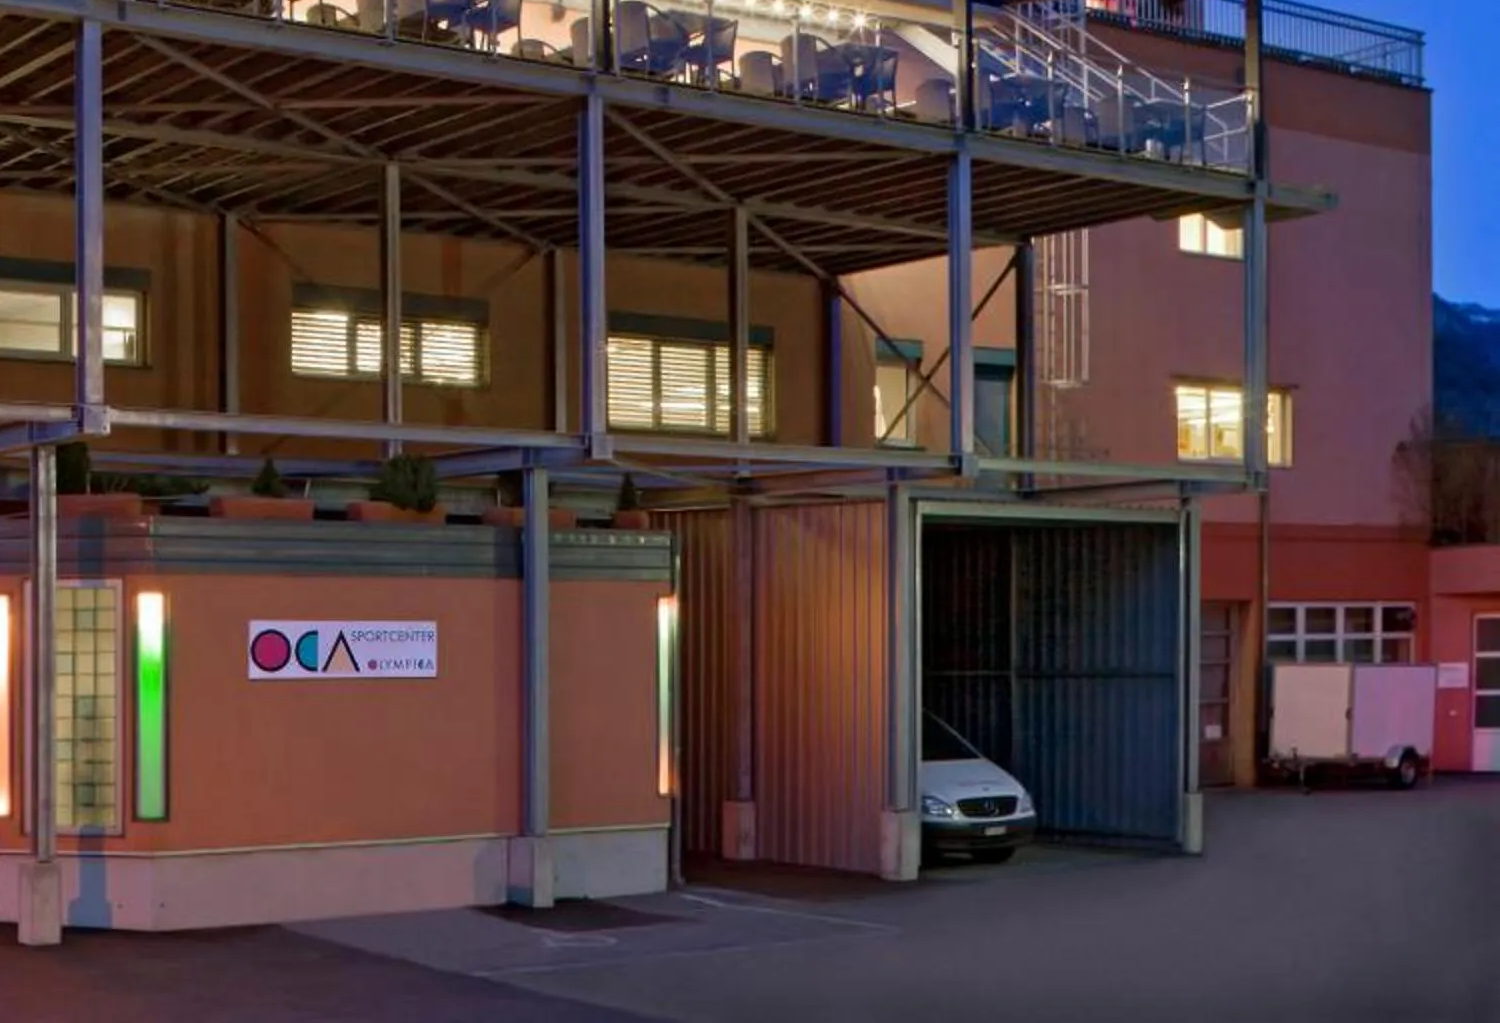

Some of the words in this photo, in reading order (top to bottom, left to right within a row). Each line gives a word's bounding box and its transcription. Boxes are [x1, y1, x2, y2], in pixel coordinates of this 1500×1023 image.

[350, 630, 434, 642] SPORTCENTER
[251, 629, 360, 673] OCA
[367, 659, 434, 670] OLYMPICA
